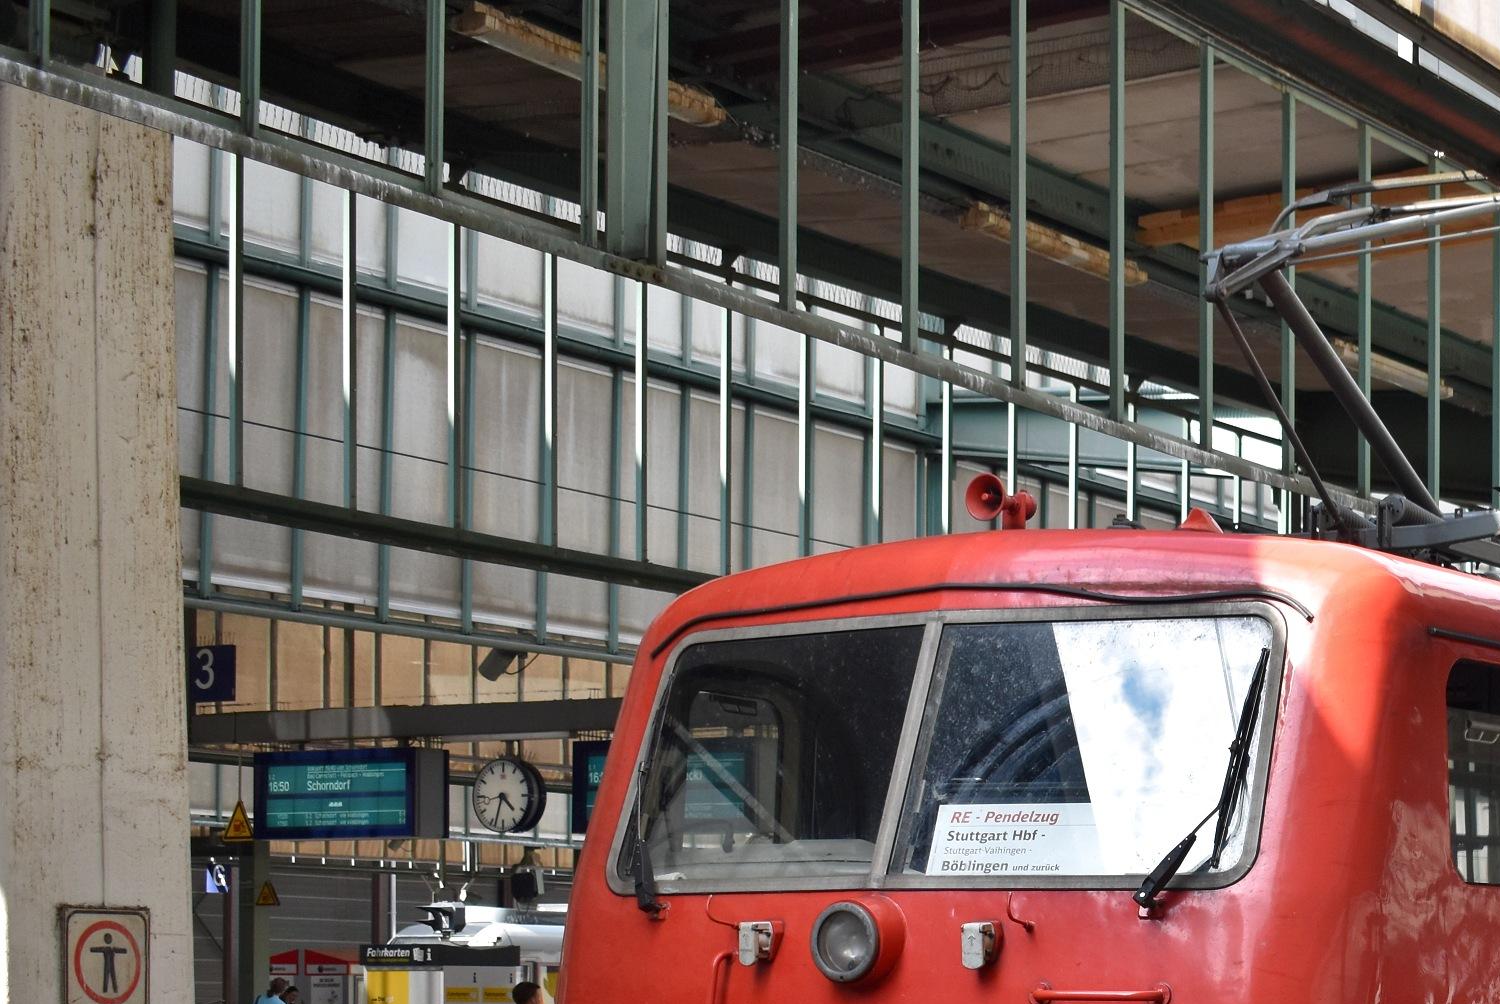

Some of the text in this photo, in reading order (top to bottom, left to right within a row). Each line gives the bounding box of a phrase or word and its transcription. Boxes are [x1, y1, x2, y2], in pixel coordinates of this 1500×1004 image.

[195, 648, 215, 690] 3
[306, 779, 351, 791] Schorndorf
[950, 811, 972, 824] RE
[984, 811, 1060, 826] Pendelzug
[946, 830, 1008, 843] Stuttgart
[1013, 829, 1038, 841] Hbf
[941, 859, 1060, 874] Böblingen und zurück
[213, 864, 227, 887] G
[366, 947, 411, 958] Fahrkarten
